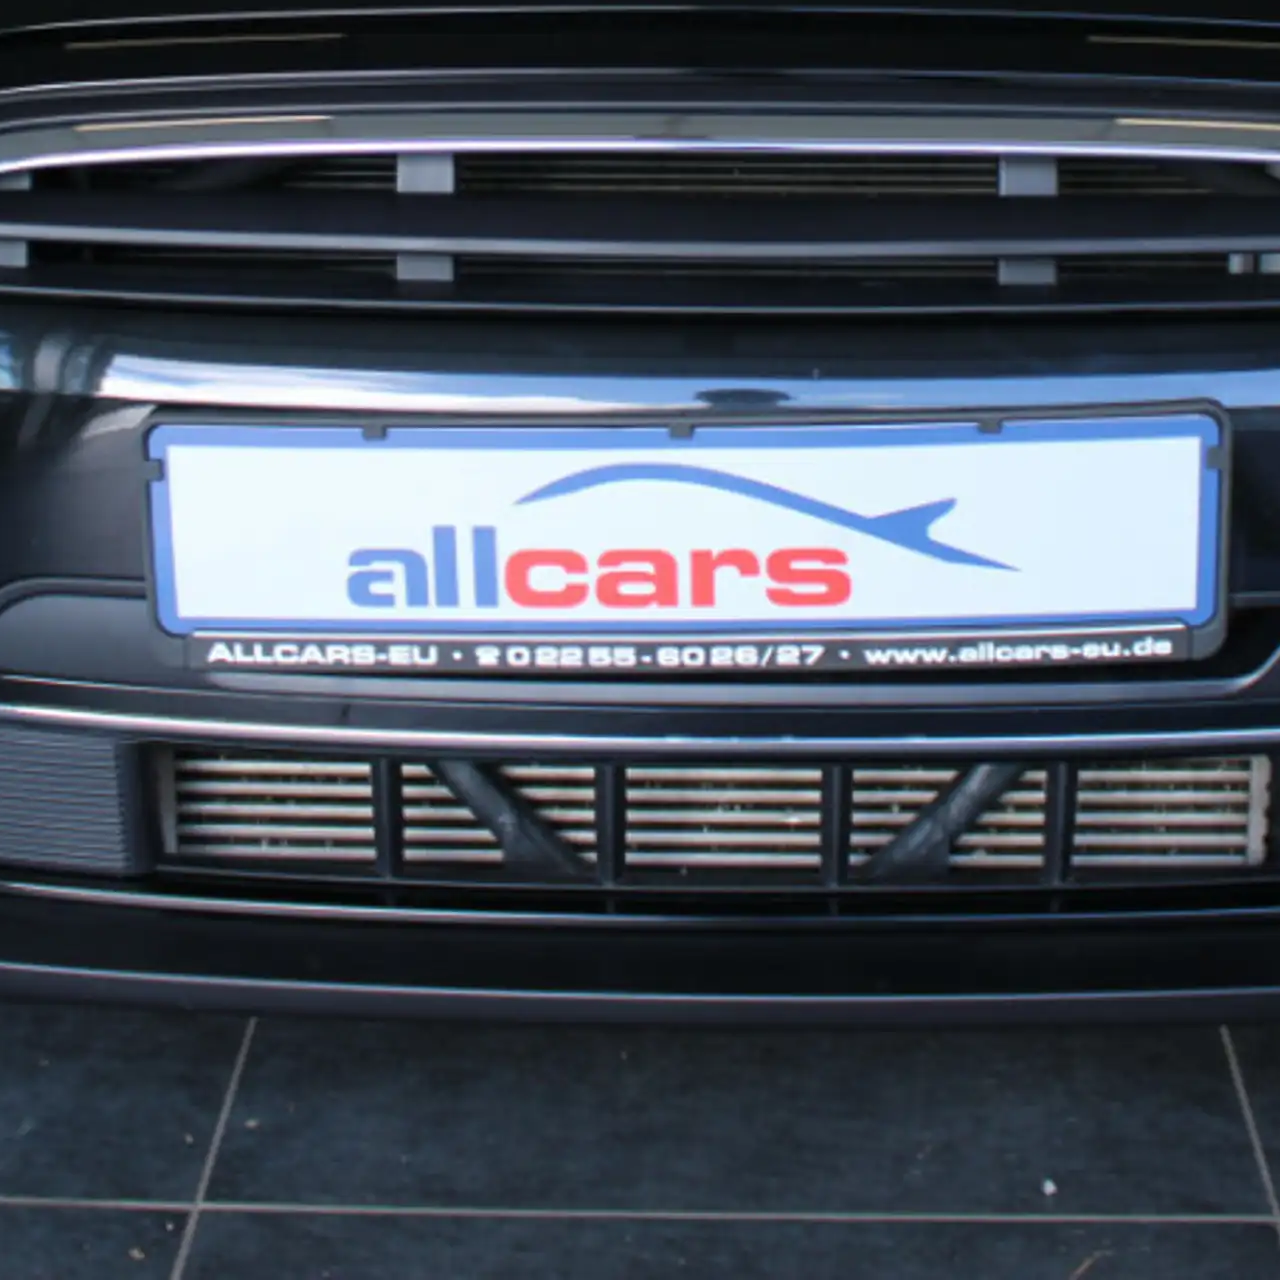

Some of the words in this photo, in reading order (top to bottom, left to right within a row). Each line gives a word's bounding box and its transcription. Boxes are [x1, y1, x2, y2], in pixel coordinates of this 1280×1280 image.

[347, 527, 852, 608] allcars
[207, 641, 439, 667] ALLCARS-EU
[862, 635, 1174, 666] www.allcars-eu.de
